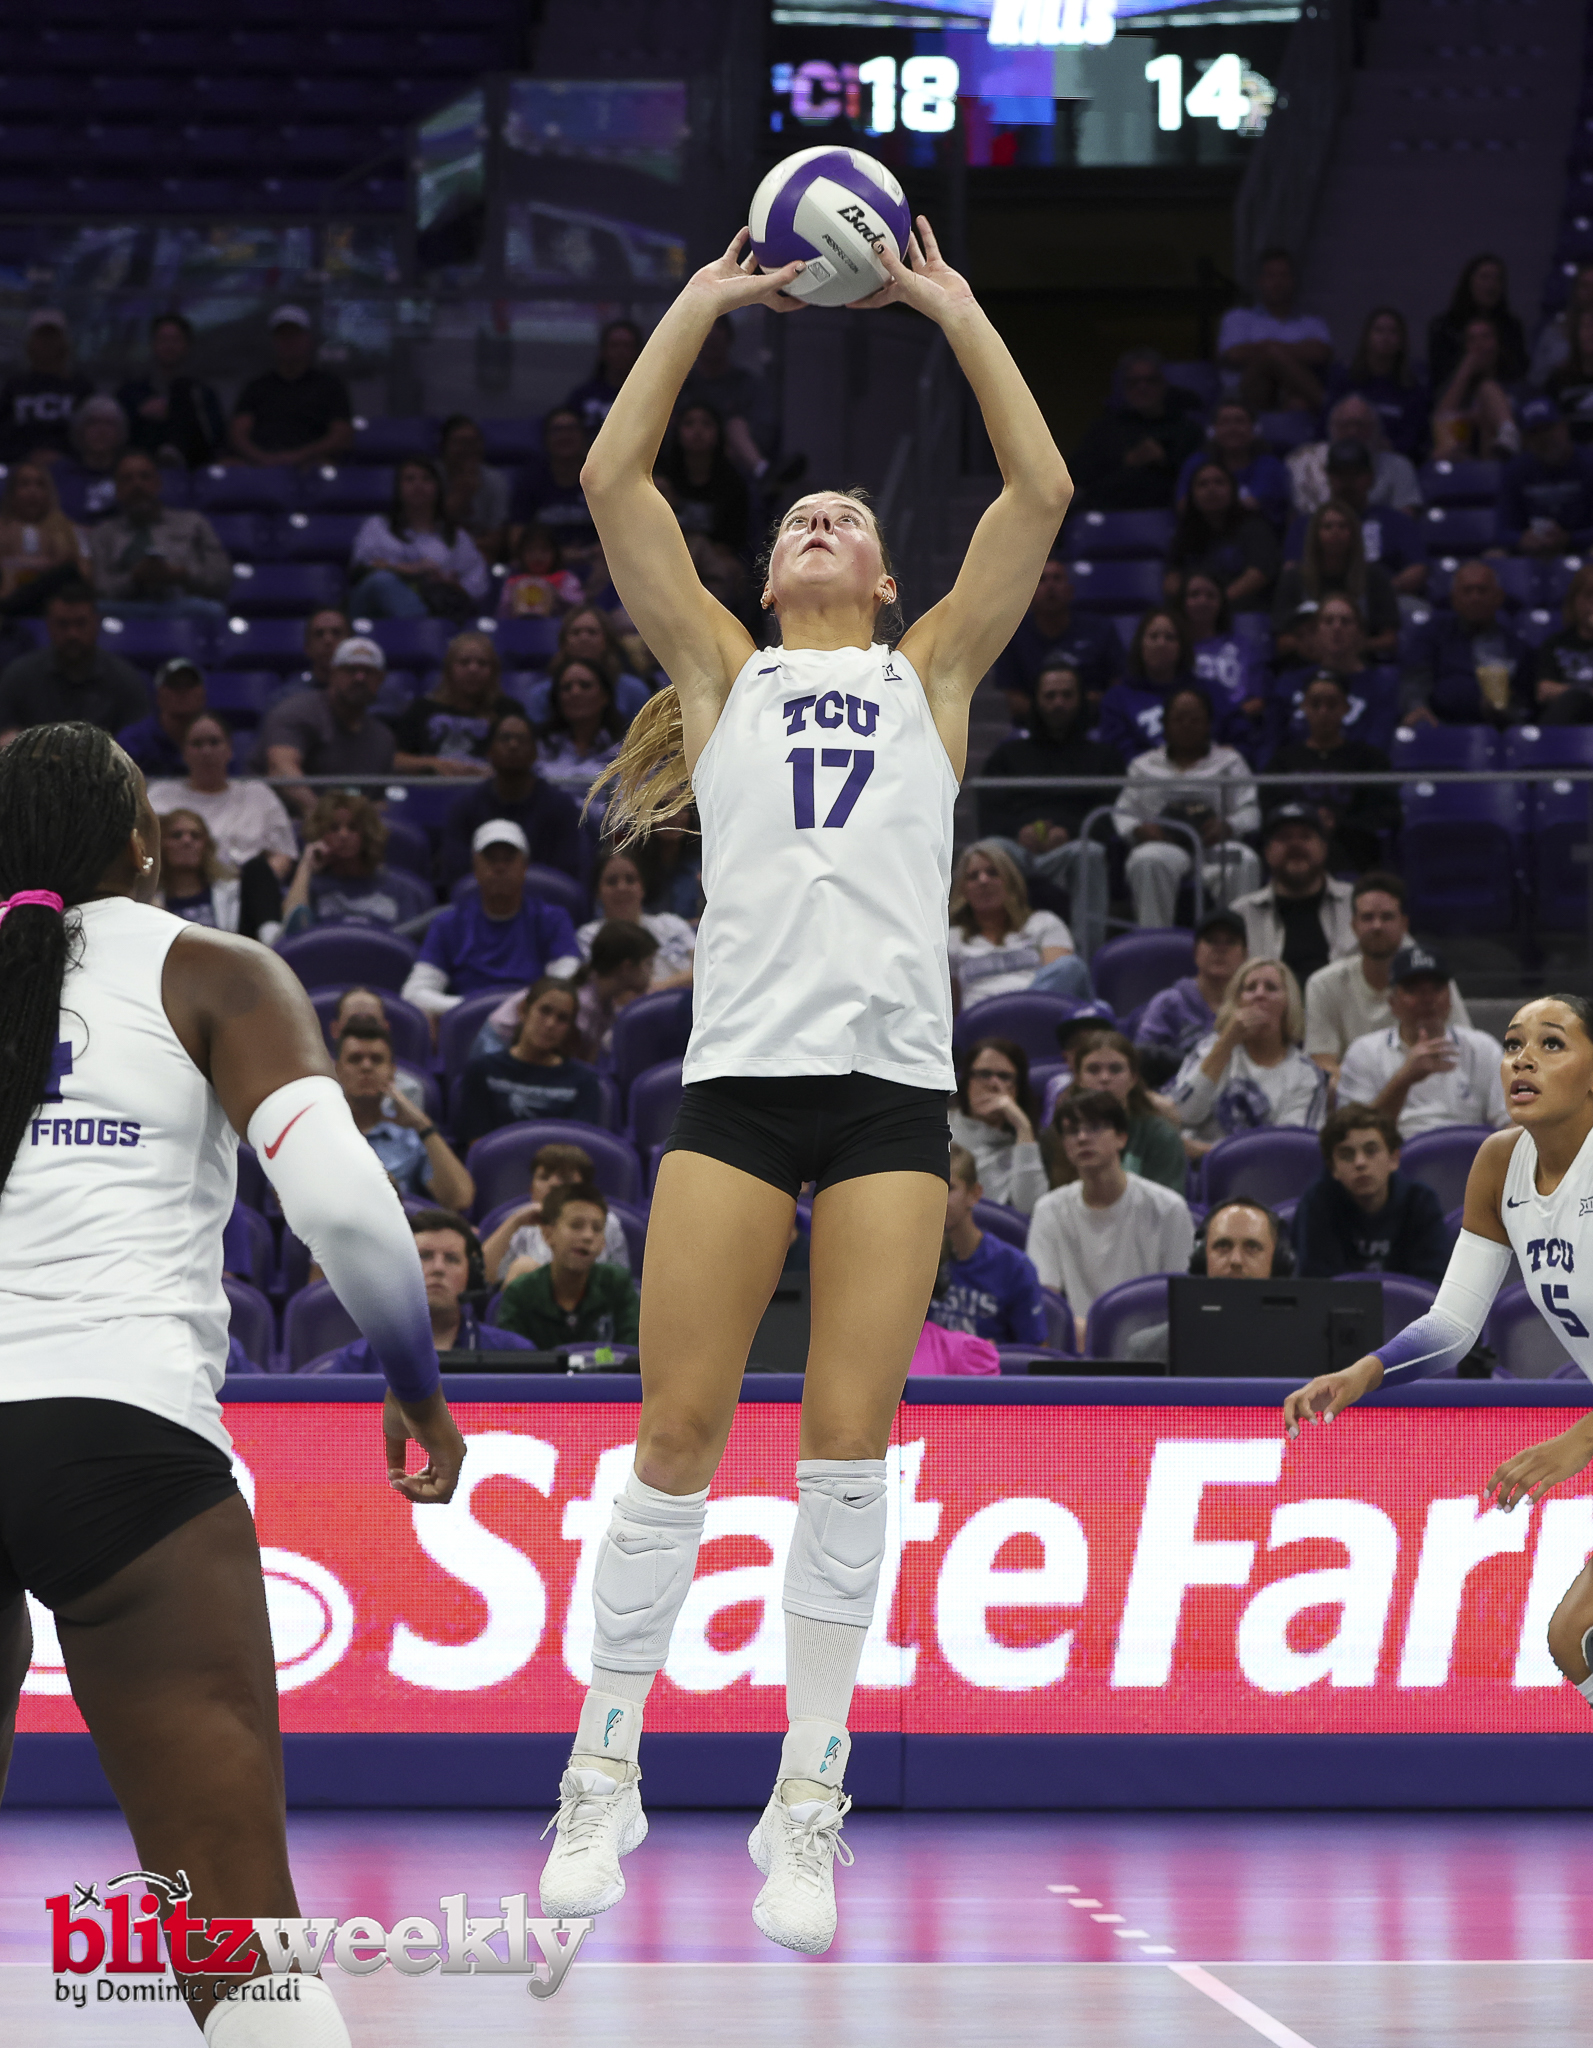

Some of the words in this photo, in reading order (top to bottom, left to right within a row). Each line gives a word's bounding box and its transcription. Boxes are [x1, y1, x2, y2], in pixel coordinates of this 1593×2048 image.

[859, 56, 959, 133] 18
[1145, 54, 1251, 131] 14
[837, 205, 886, 254] Bad
[783, 690, 880, 738] TCU
[785, 747, 875, 830] 17
[31, 1118, 142, 1147] FROGS
[1526, 1237, 1574, 1274] TCU
[1540, 1283, 1590, 1339] 5
